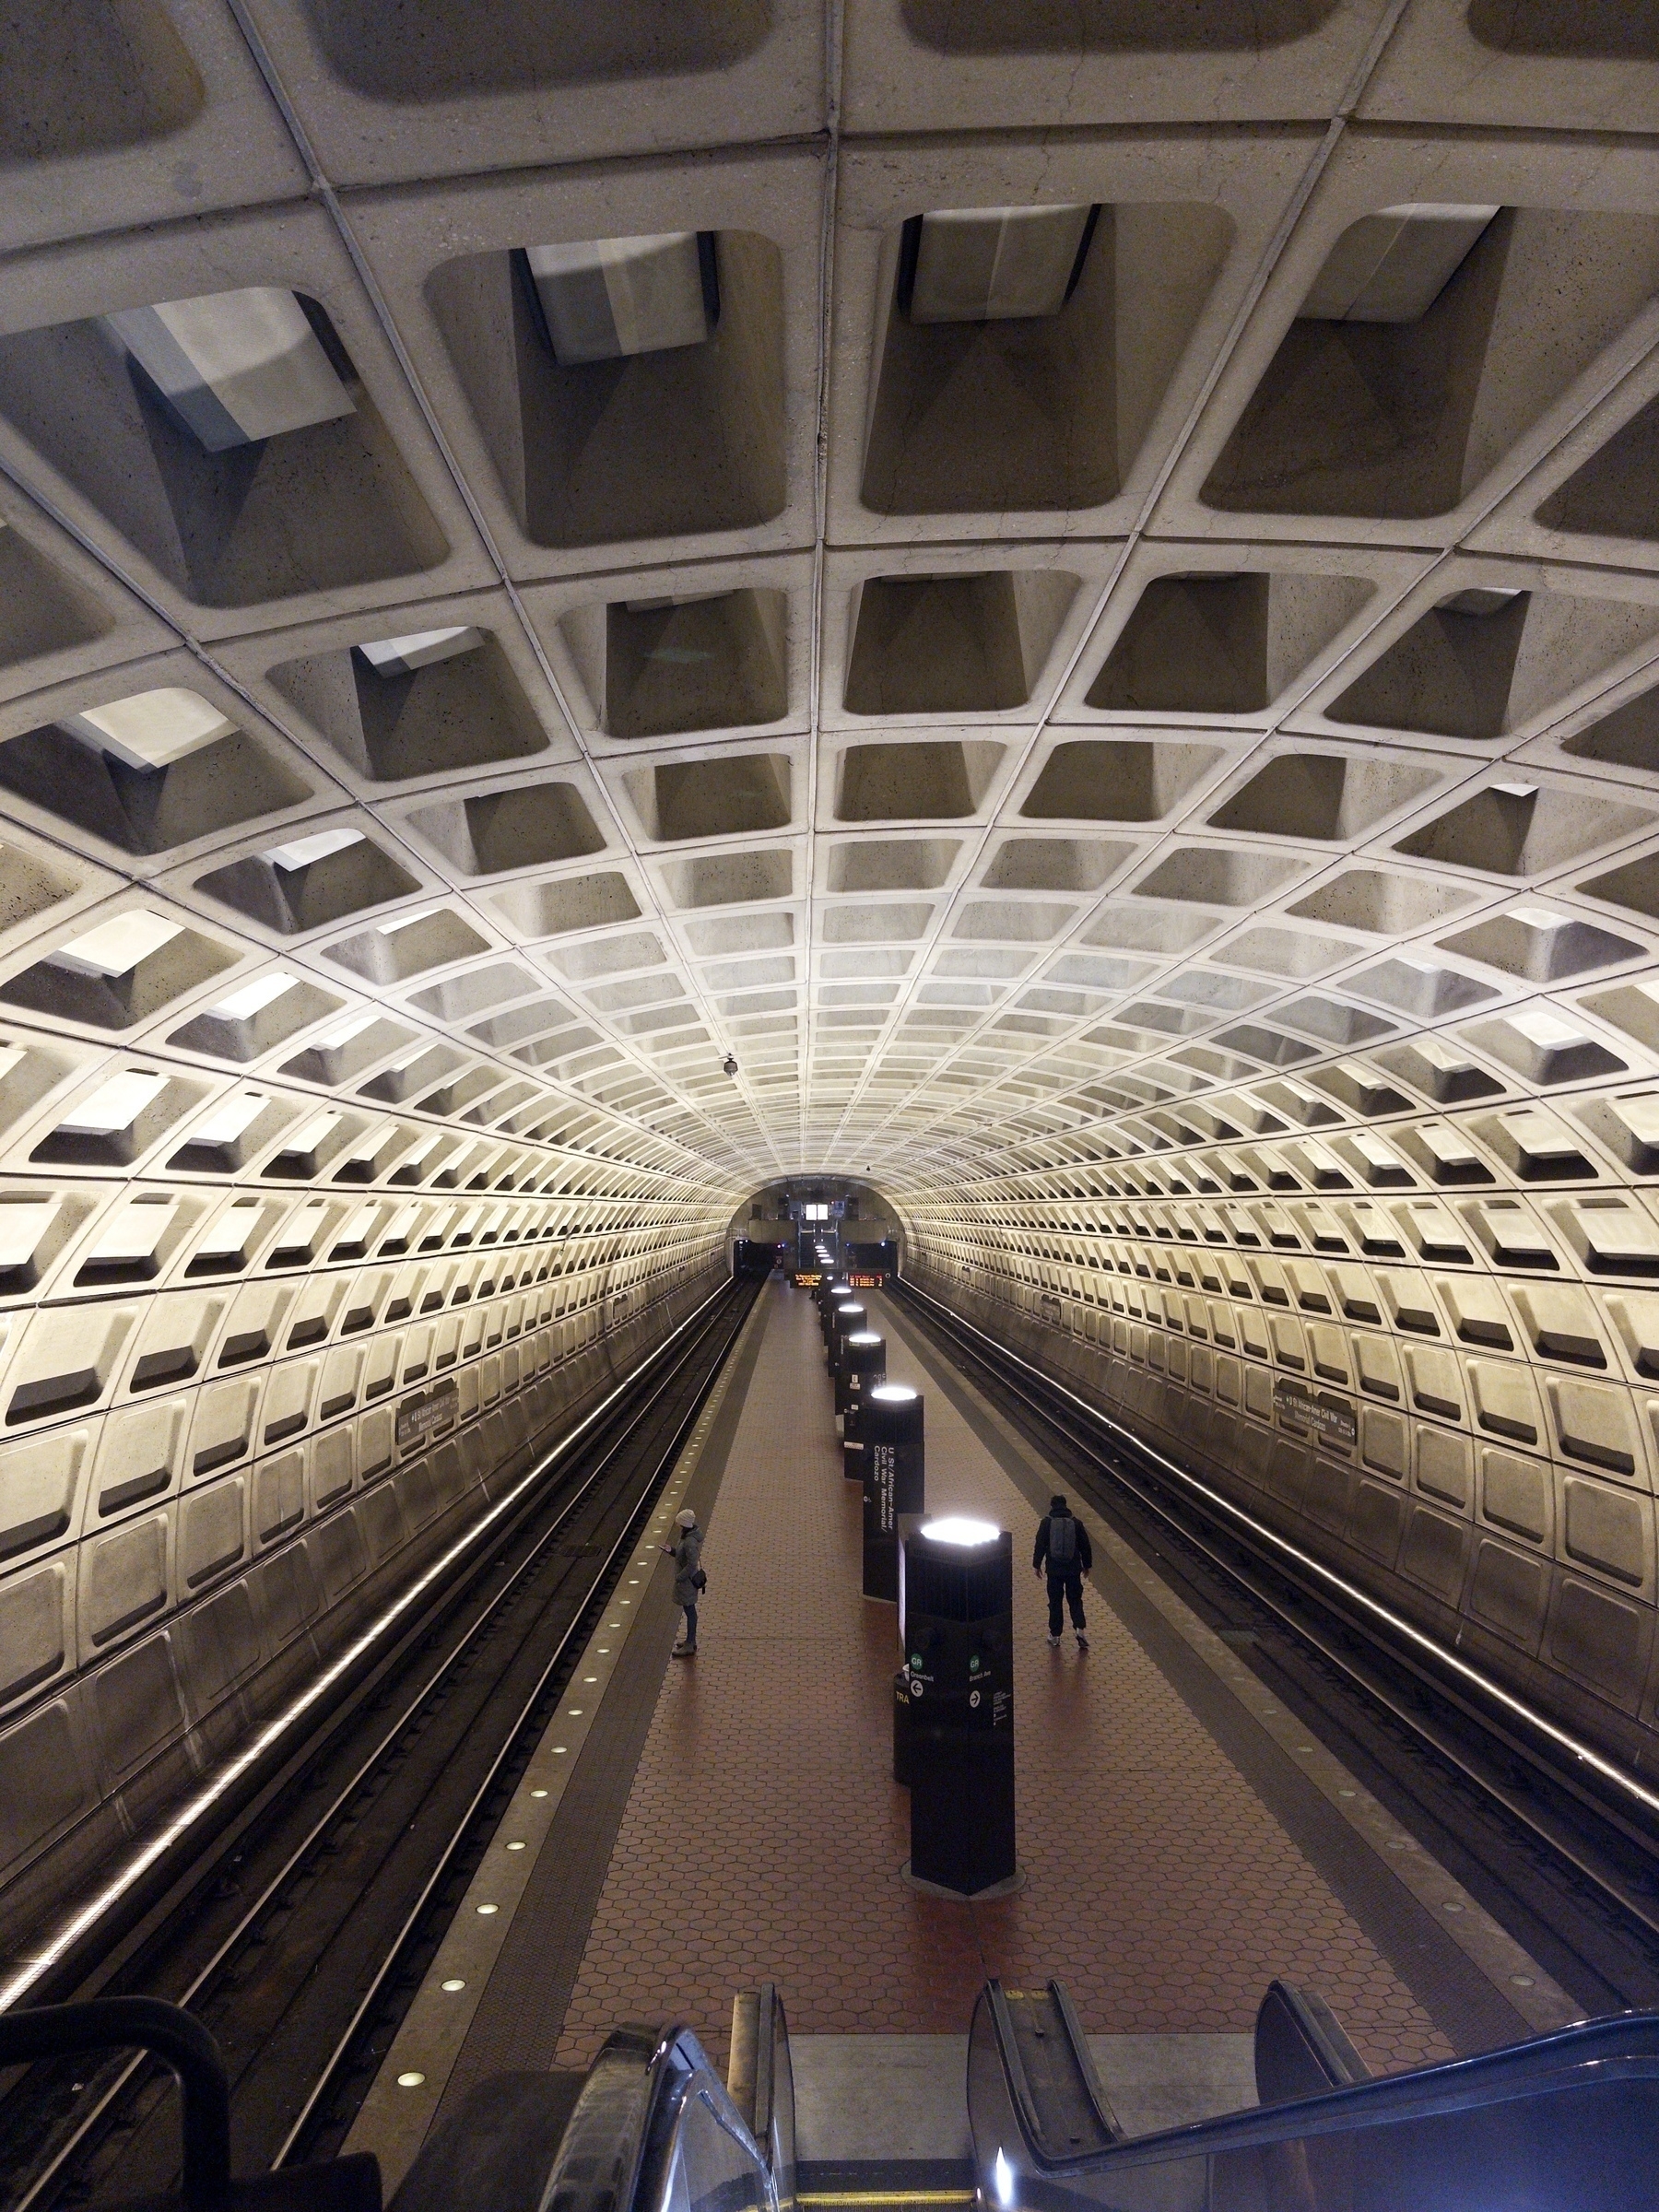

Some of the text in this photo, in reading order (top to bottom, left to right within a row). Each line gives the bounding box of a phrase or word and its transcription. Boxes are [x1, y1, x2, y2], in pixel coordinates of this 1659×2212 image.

[911, 1658, 922, 1666] GR
[971, 1659, 979, 1668] GR
[911, 1671, 934, 1682] Greenbelt
[969, 1673, 982, 1682] Branch
[895, 1691, 910, 1704] TRA
